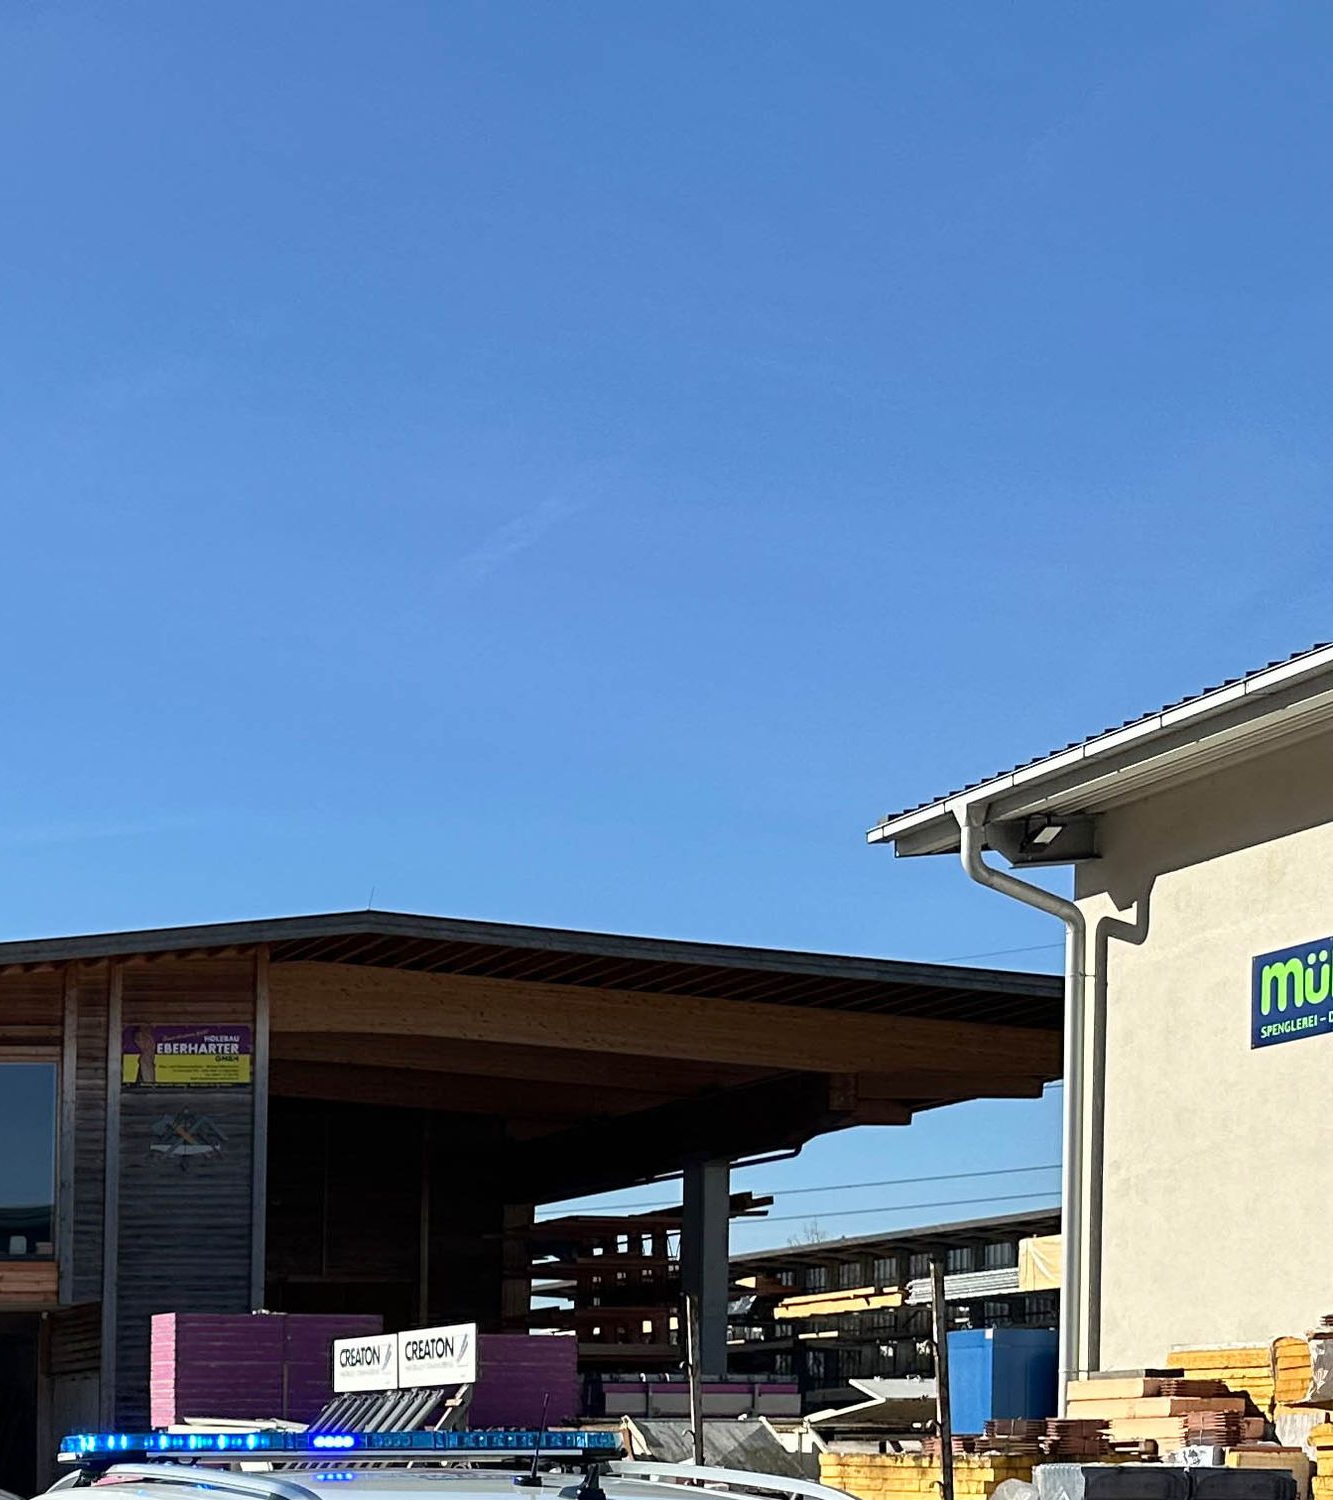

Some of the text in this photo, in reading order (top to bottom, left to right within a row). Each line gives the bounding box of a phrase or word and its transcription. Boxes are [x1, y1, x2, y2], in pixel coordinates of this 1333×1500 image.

[1260, 949, 1333, 1016] mü
[1260, 1014, 1318, 1039] SPENGLEREI
[156, 1043, 240, 1054] EBERHARTER
[204, 1035, 240, 1043] HOLZBAU
[339, 1345, 381, 1368] CREATON
[404, 1335, 454, 1361] CREATON
